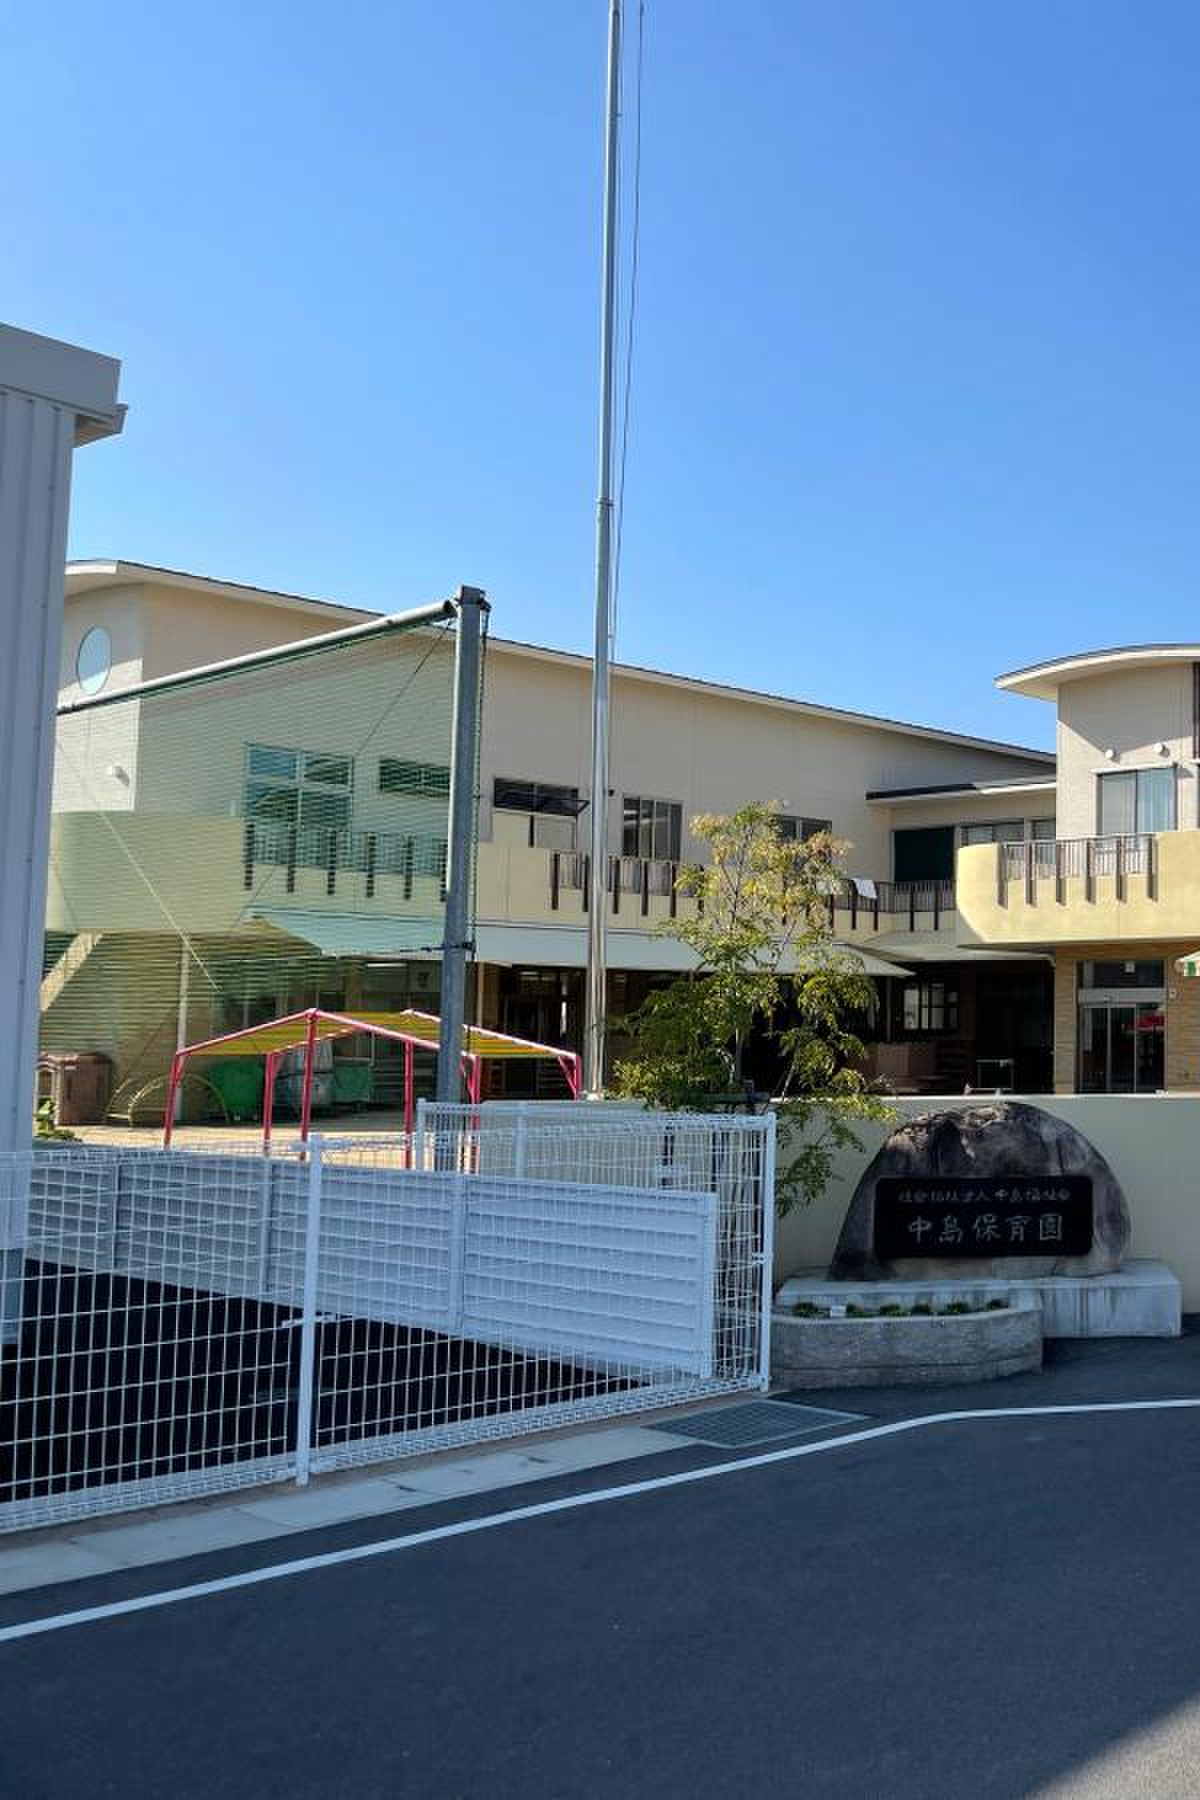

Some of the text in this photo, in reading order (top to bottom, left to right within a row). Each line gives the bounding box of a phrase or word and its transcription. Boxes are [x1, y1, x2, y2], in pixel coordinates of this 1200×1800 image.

[908, 1214, 1062, 1243] 中島保育園
